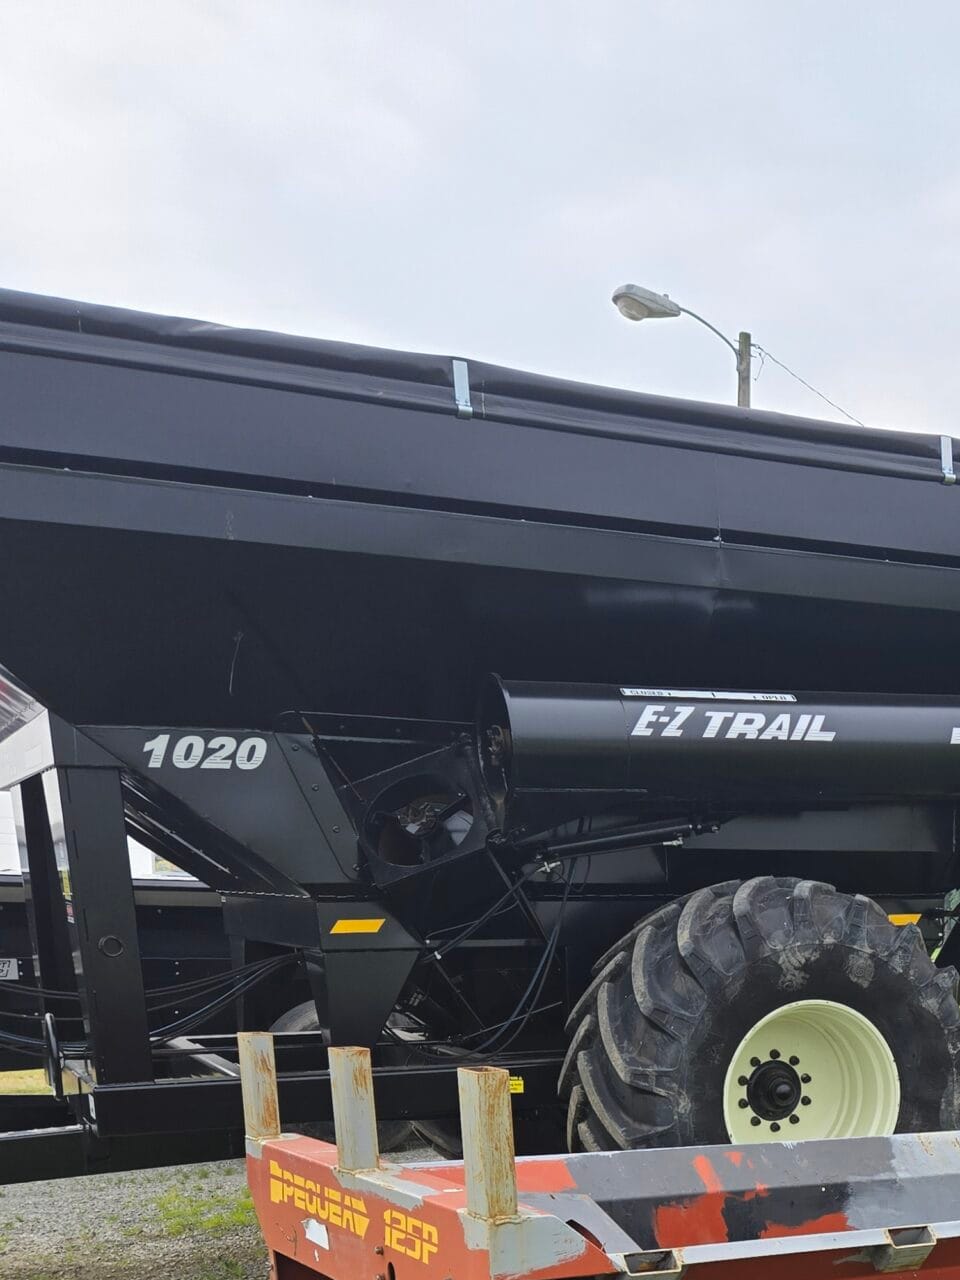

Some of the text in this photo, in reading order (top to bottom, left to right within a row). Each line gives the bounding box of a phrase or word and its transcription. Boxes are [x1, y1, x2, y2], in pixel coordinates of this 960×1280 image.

[630, 704, 837, 742] E-Z TRAIL
[142, 734, 267, 770] 1020
[282, 1168, 438, 1265] PEQUEA 125P
